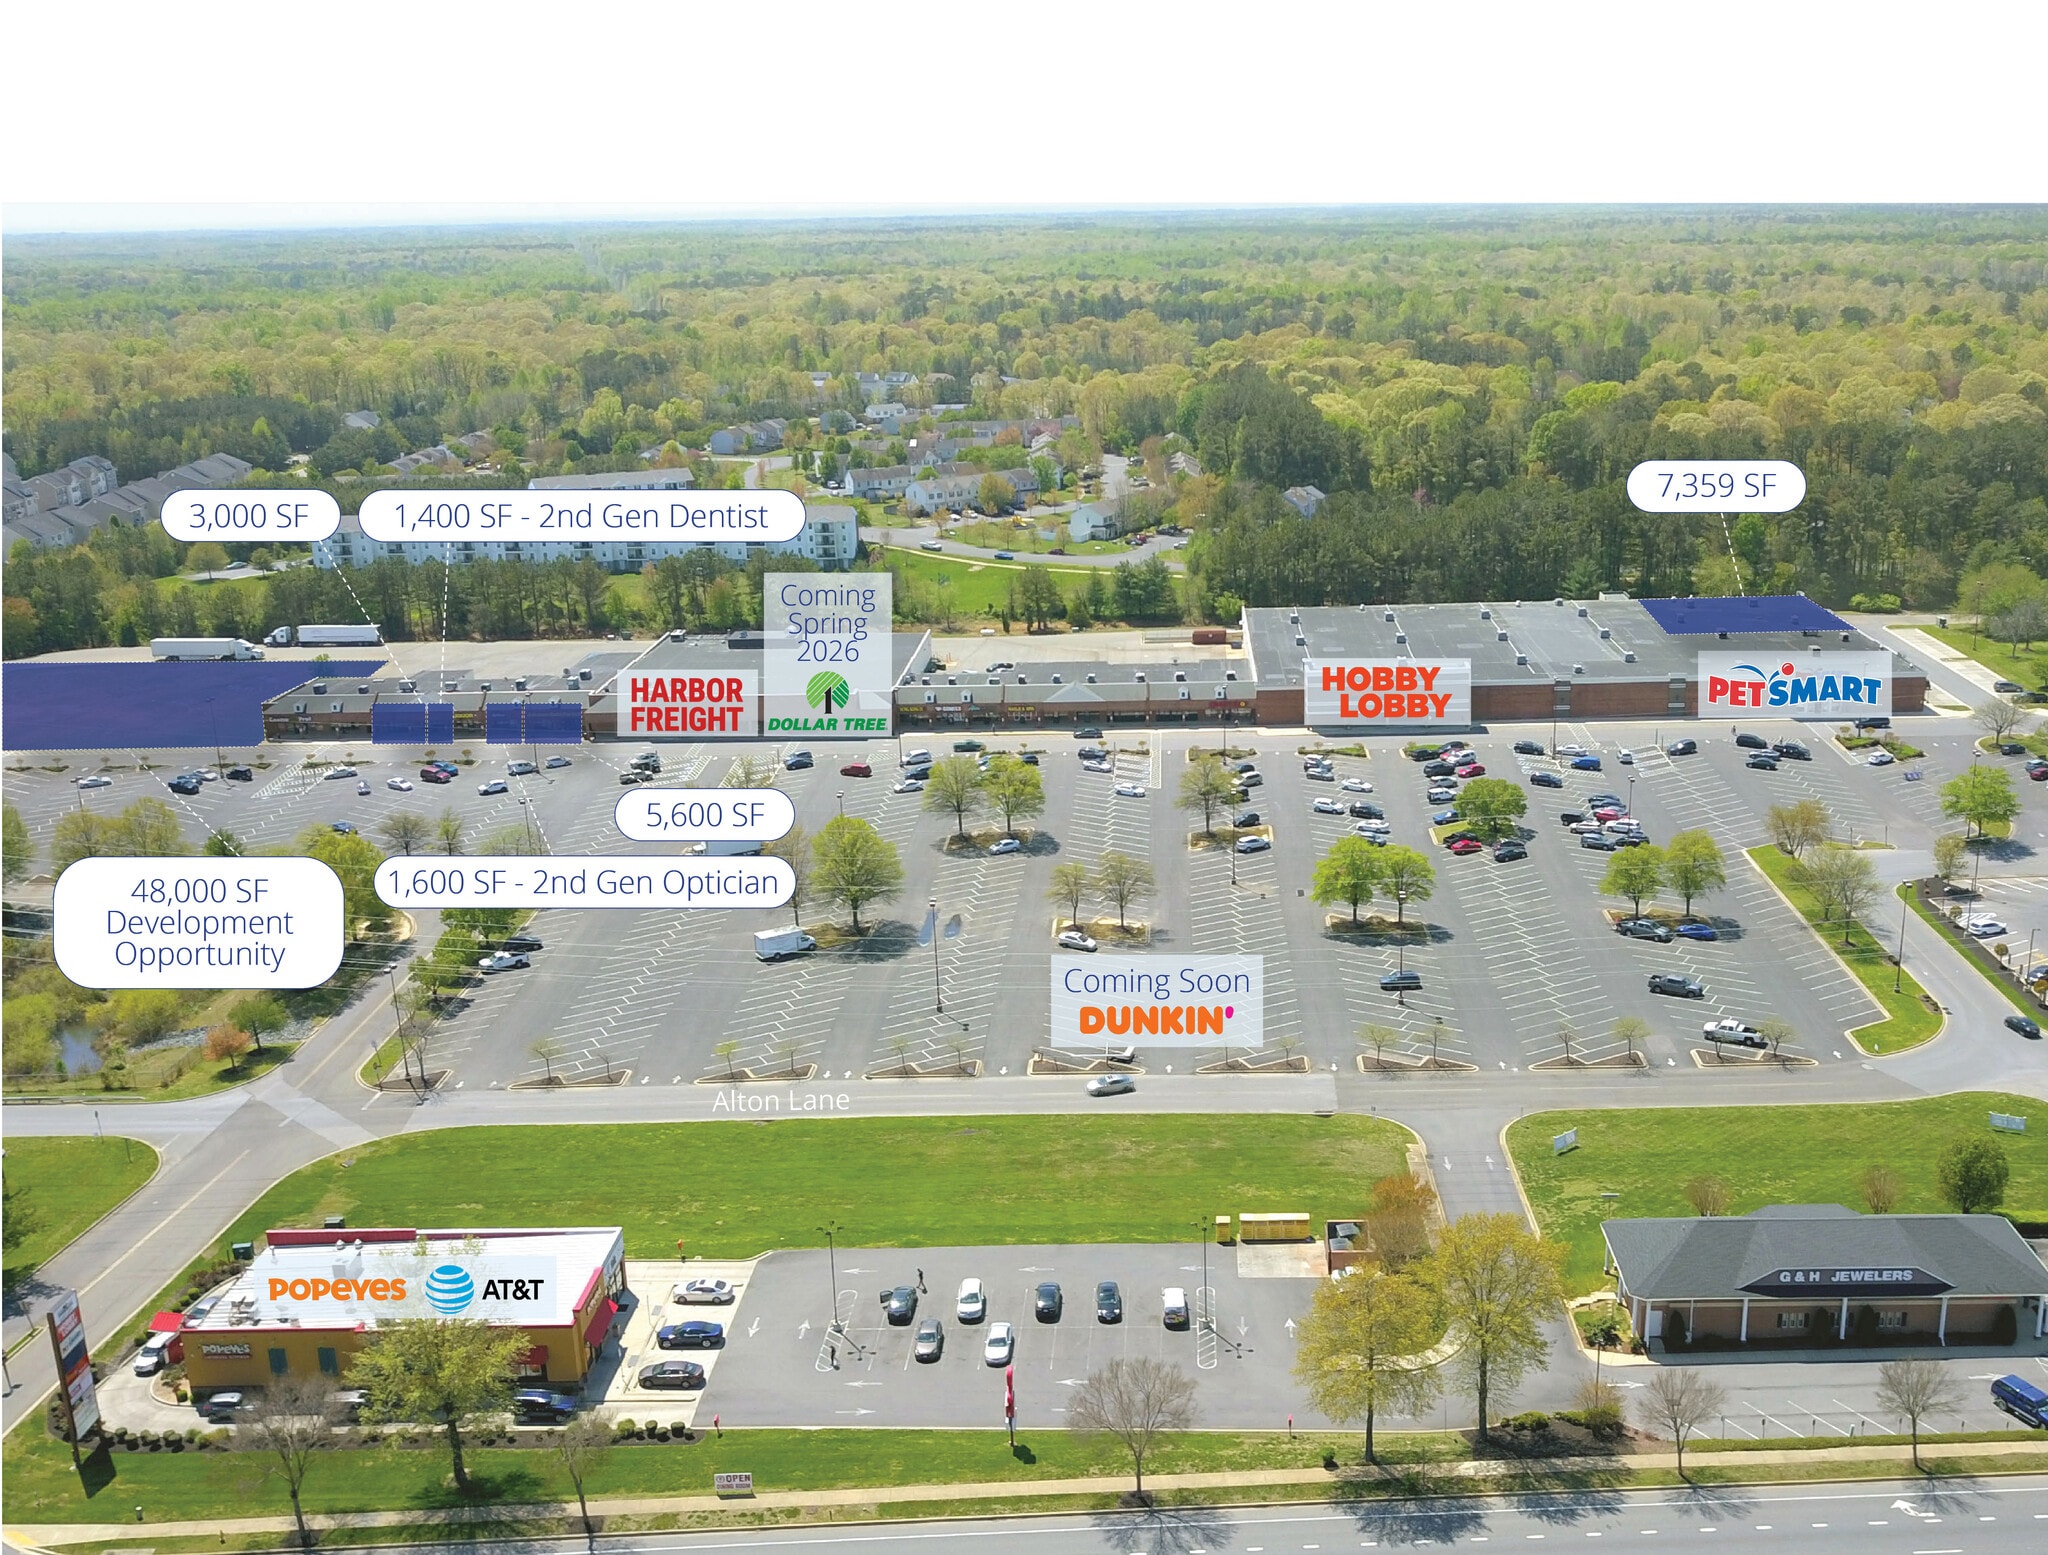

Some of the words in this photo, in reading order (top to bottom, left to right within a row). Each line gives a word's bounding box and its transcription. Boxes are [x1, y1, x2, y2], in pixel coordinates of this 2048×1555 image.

[1779, 1271, 1791, 1283] G
[1794, 1271, 1805, 1282] &
[1809, 1271, 1821, 1282] H
[1831, 1270, 1913, 1282] JEWELERS
